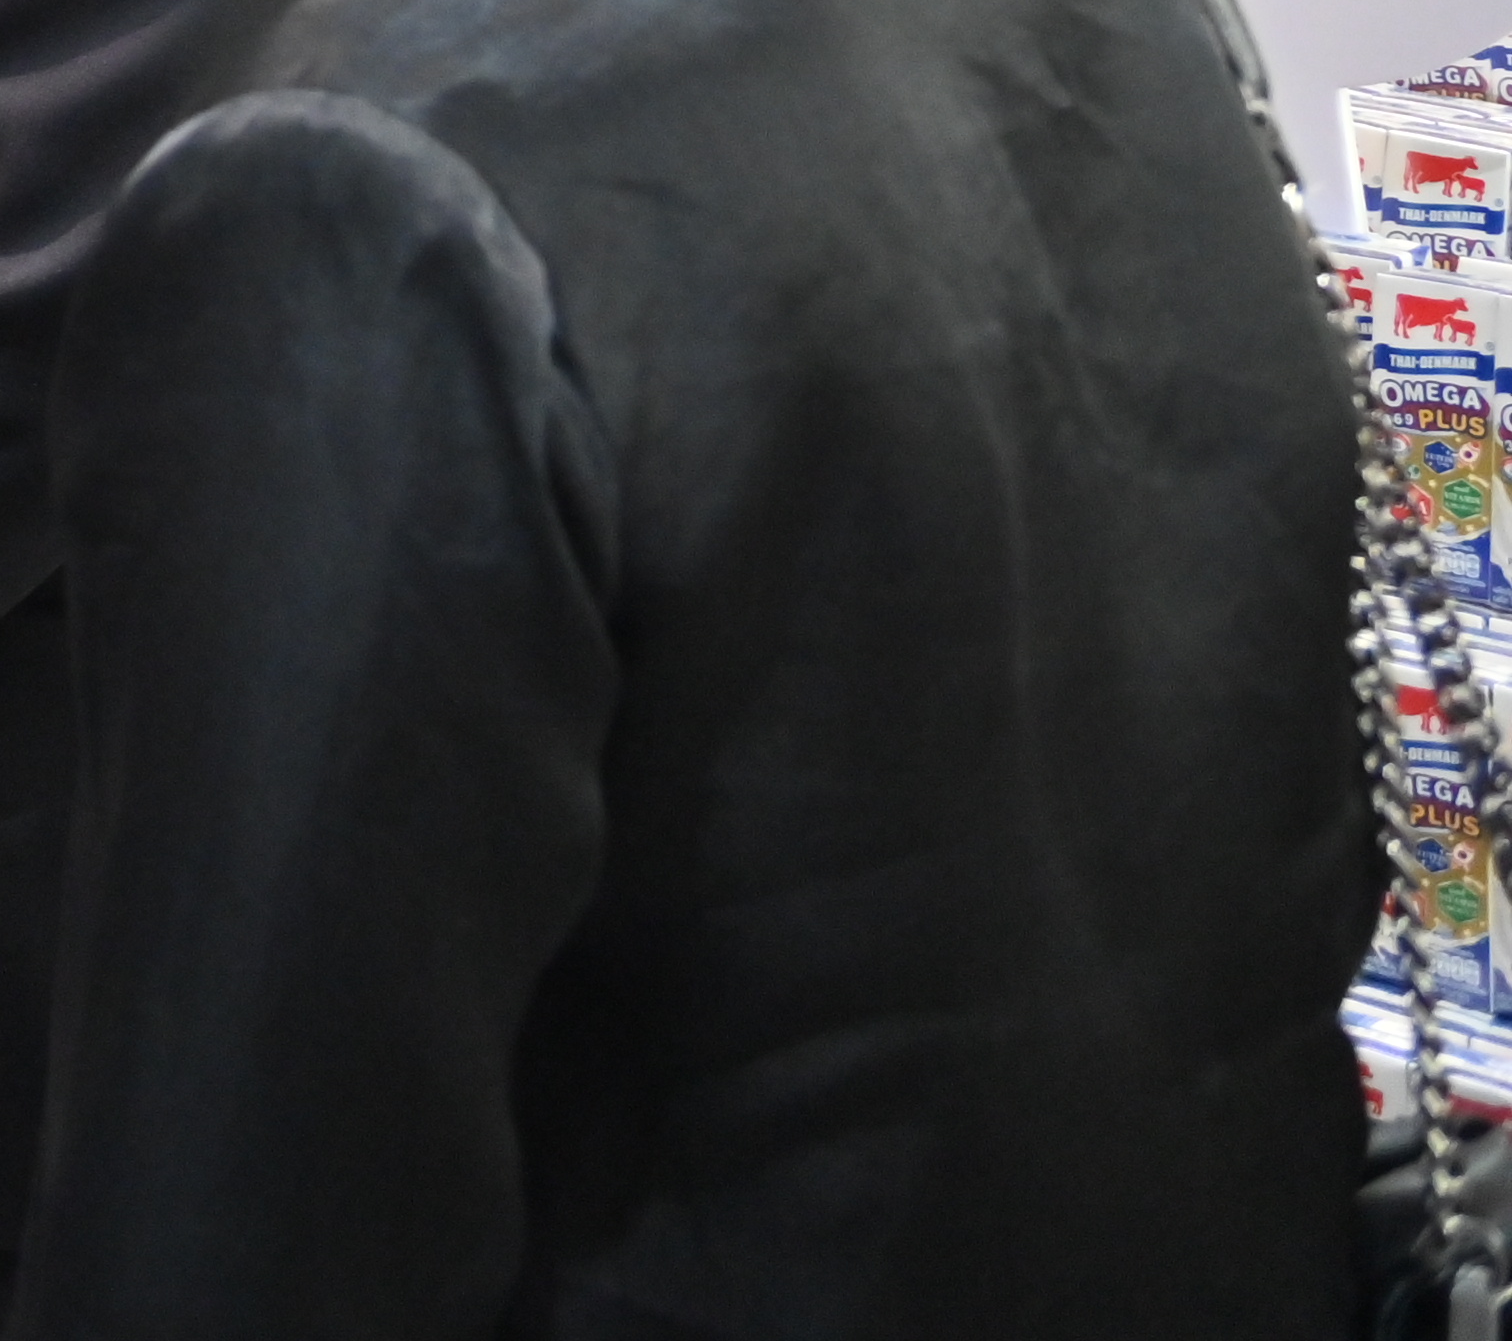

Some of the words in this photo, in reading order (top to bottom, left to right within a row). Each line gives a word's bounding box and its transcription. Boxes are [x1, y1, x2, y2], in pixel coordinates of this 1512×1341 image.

[1397, 206, 1486, 225] THAI-DENMARK
[1388, 353, 1477, 372] THAI-DENMARK
[1380, 380, 1482, 410] OMEGA
[1417, 408, 1487, 436] PLUS
